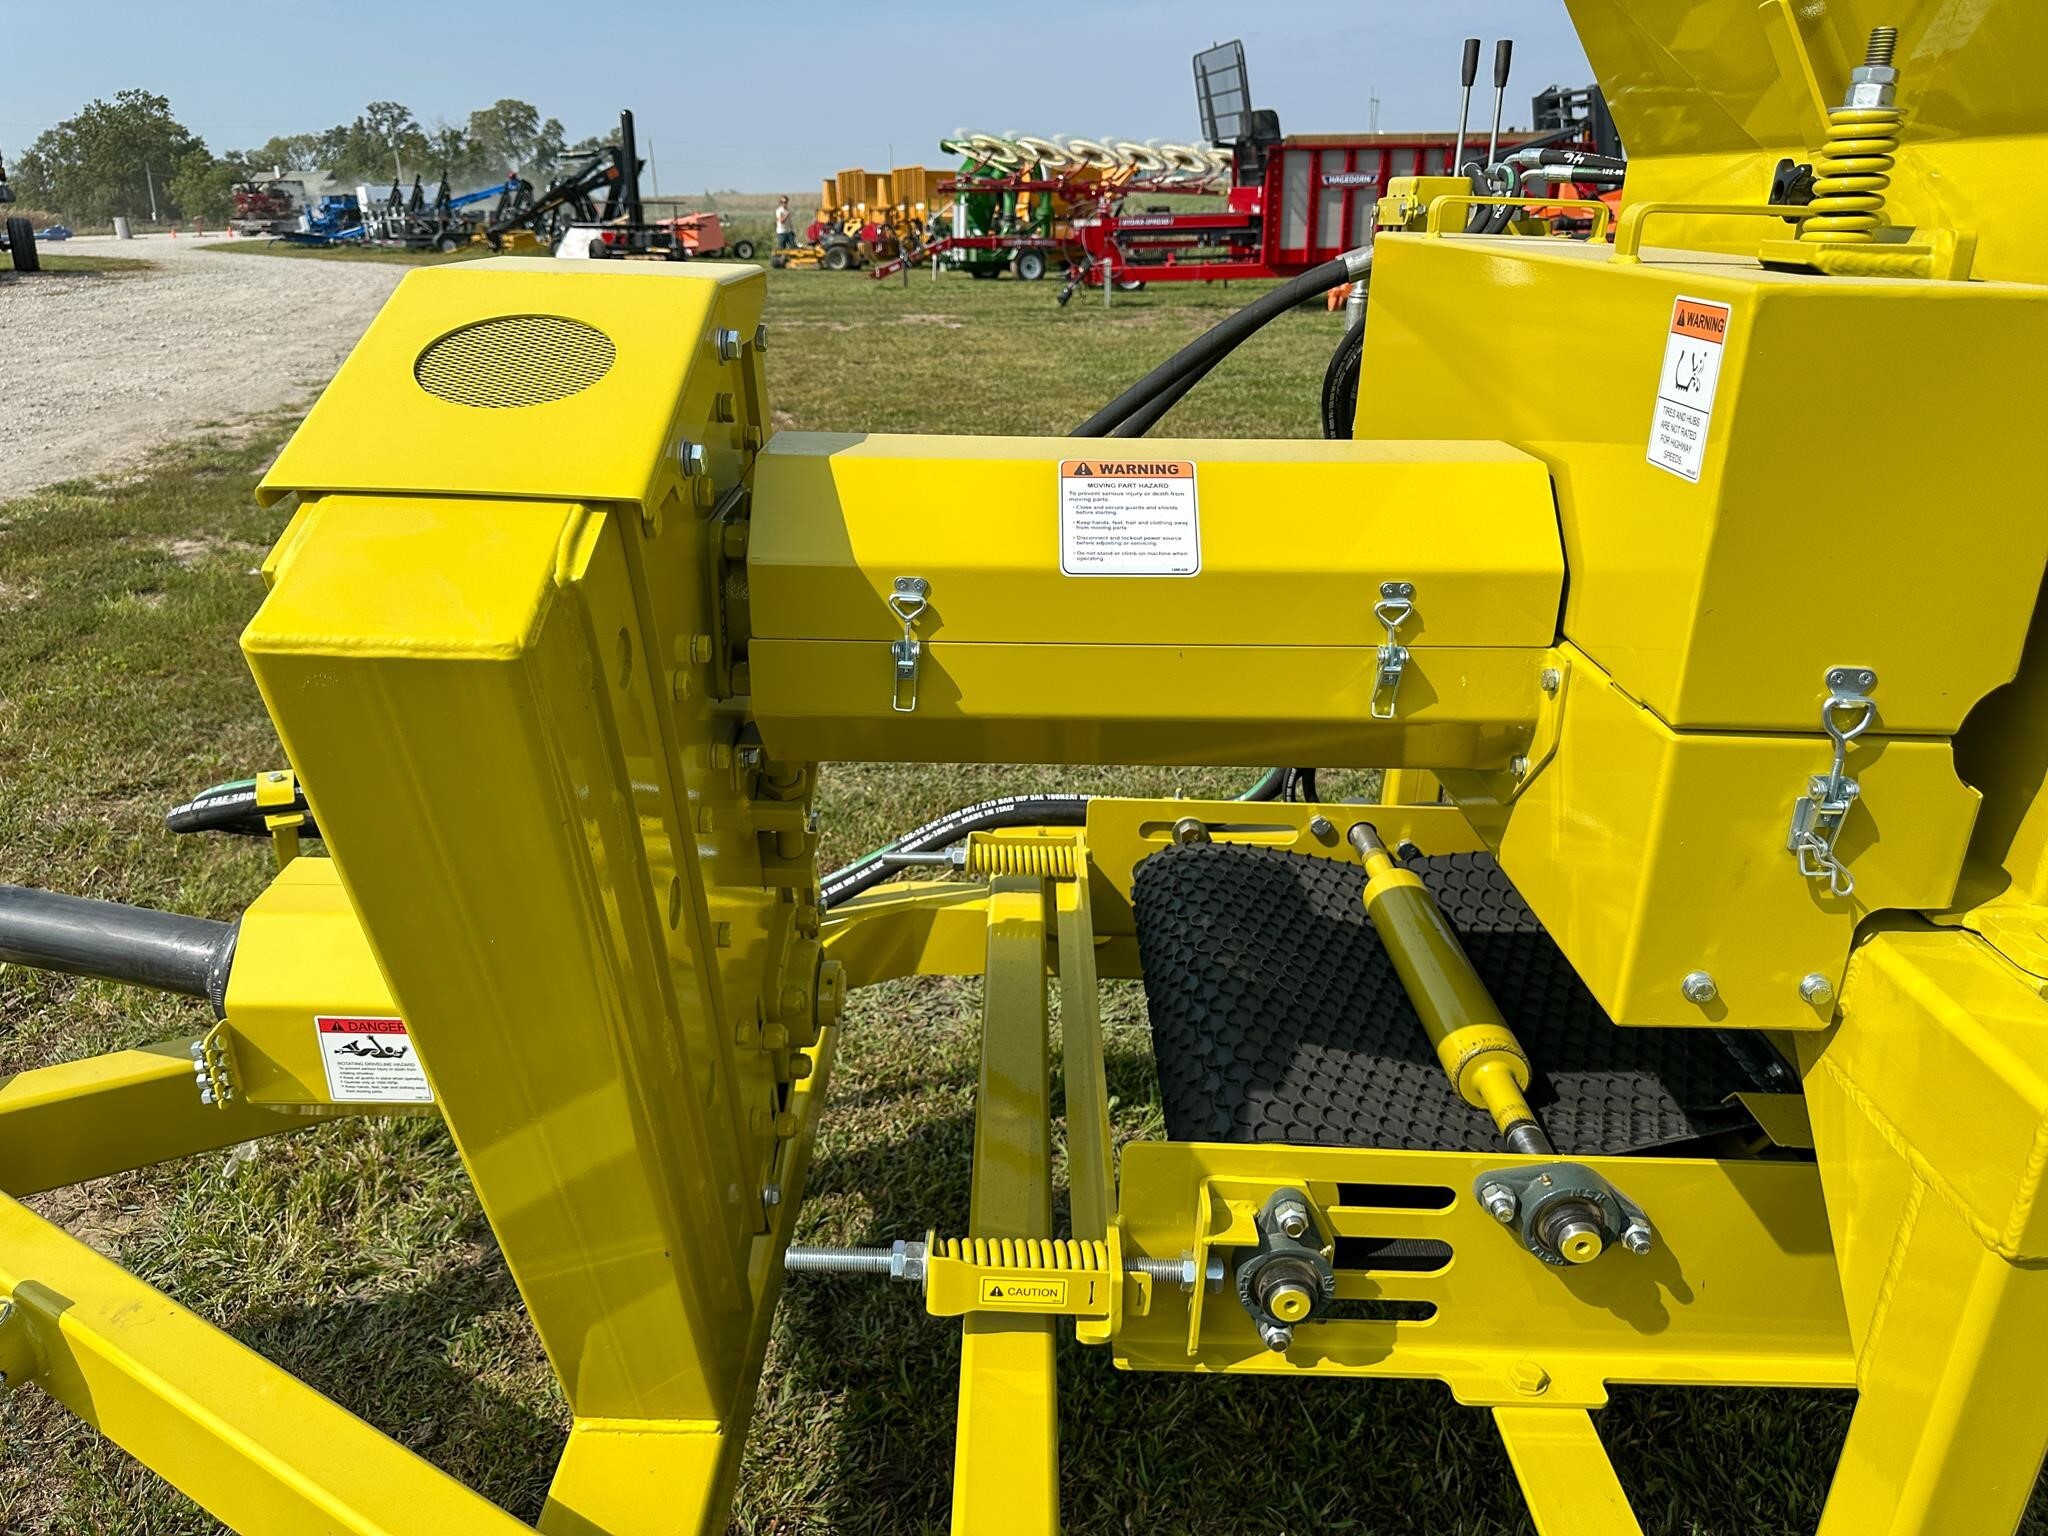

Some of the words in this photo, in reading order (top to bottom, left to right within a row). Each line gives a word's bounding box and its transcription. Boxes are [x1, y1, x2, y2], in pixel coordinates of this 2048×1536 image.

[1686, 311, 1725, 333] WARNING
[1662, 405, 1676, 418] TIRES
[1676, 411, 1686, 422] AND
[1686, 414, 1700, 428] HUBS
[1660, 420, 1671, 431] ARE
[1671, 424, 1682, 434] NOT
[1680, 427, 1697, 441] RATED
[1660, 434, 1671, 444] FOR
[1670, 438, 1692, 454] HIGHWAY
[1099, 464, 1179, 474] WARNING
[208, 794, 230, 806] SAE
[961, 804, 976, 816] PSI
[998, 796, 1014, 805] BAR
[961, 811, 984, 824] MADE
[984, 808, 995, 816] IN
[995, 804, 1015, 814] ITALY
[842, 874, 856, 887] WP
[348, 1022, 406, 1032] DANGER
[1007, 1287, 1058, 1297] CAUTION
